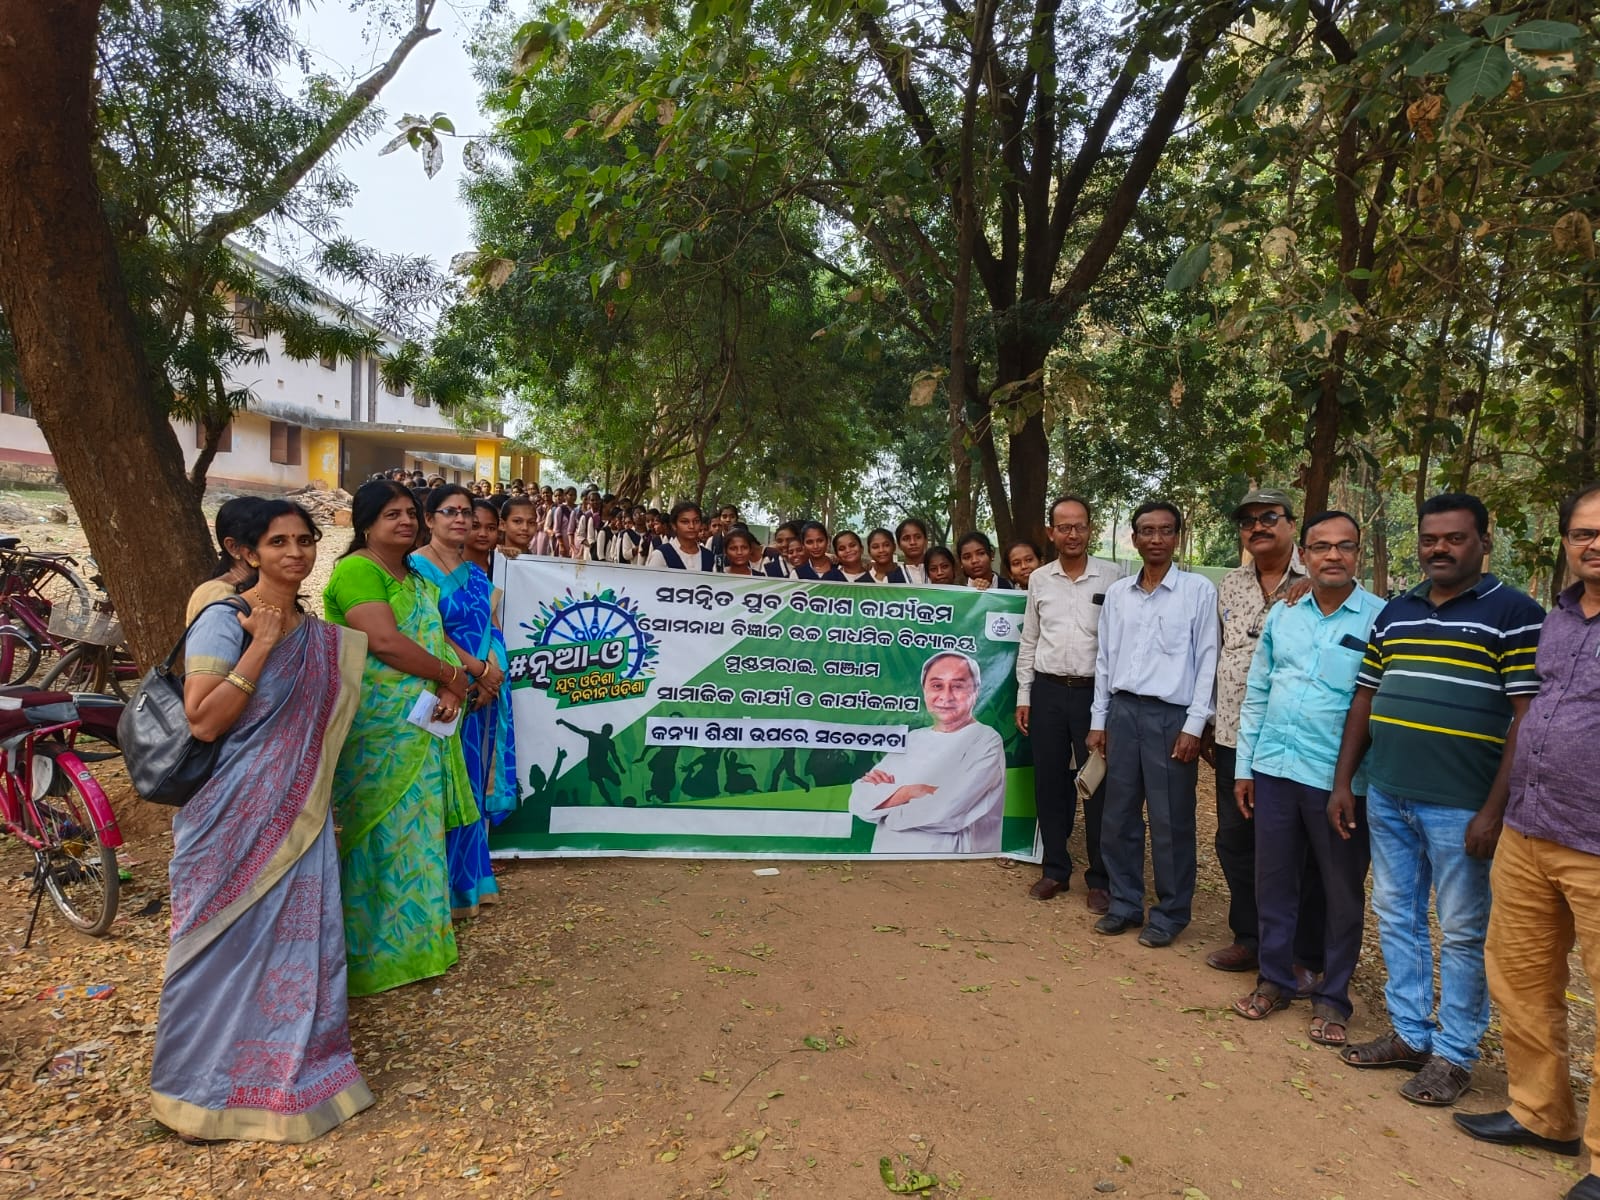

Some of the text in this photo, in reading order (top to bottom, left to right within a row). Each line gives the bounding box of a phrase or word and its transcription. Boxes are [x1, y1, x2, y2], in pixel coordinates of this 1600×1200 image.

[742, 592, 782, 613] ଯୁବ
[790, 591, 853, 615] ବିକାଶ
[638, 617, 725, 635] ସୋମନାଥ
[657, 683, 734, 703] ସାମାଜିକ
[796, 692, 813, 706] ଓ
[651, 725, 699, 742] କନ୍ୟା
[749, 727, 809, 743] ଉପରେ
